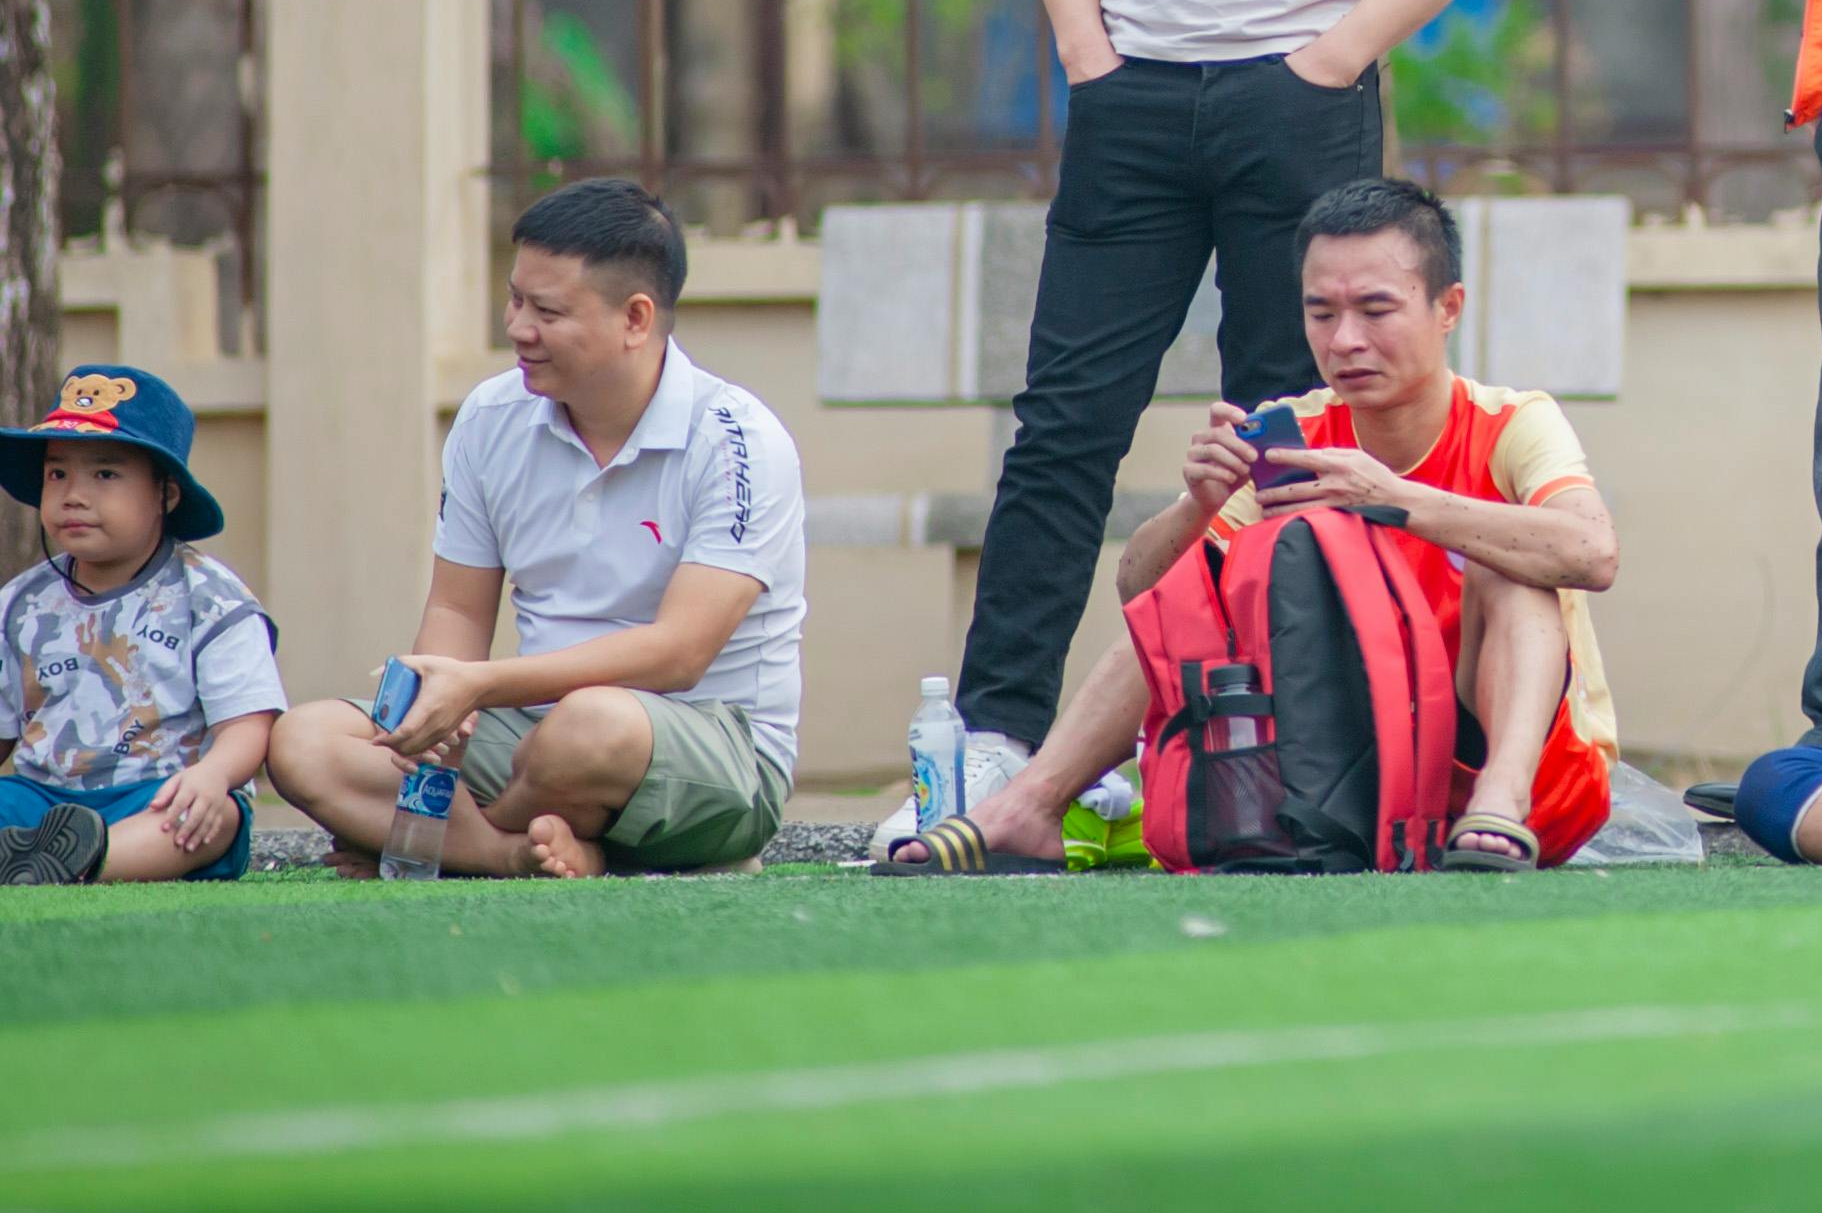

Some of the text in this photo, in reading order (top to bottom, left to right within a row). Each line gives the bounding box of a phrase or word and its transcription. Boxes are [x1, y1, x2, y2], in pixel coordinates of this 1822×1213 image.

[137, 624, 180, 650] BOY
[38, 657, 79, 681] BOY
[113, 718, 145, 755] BOY
